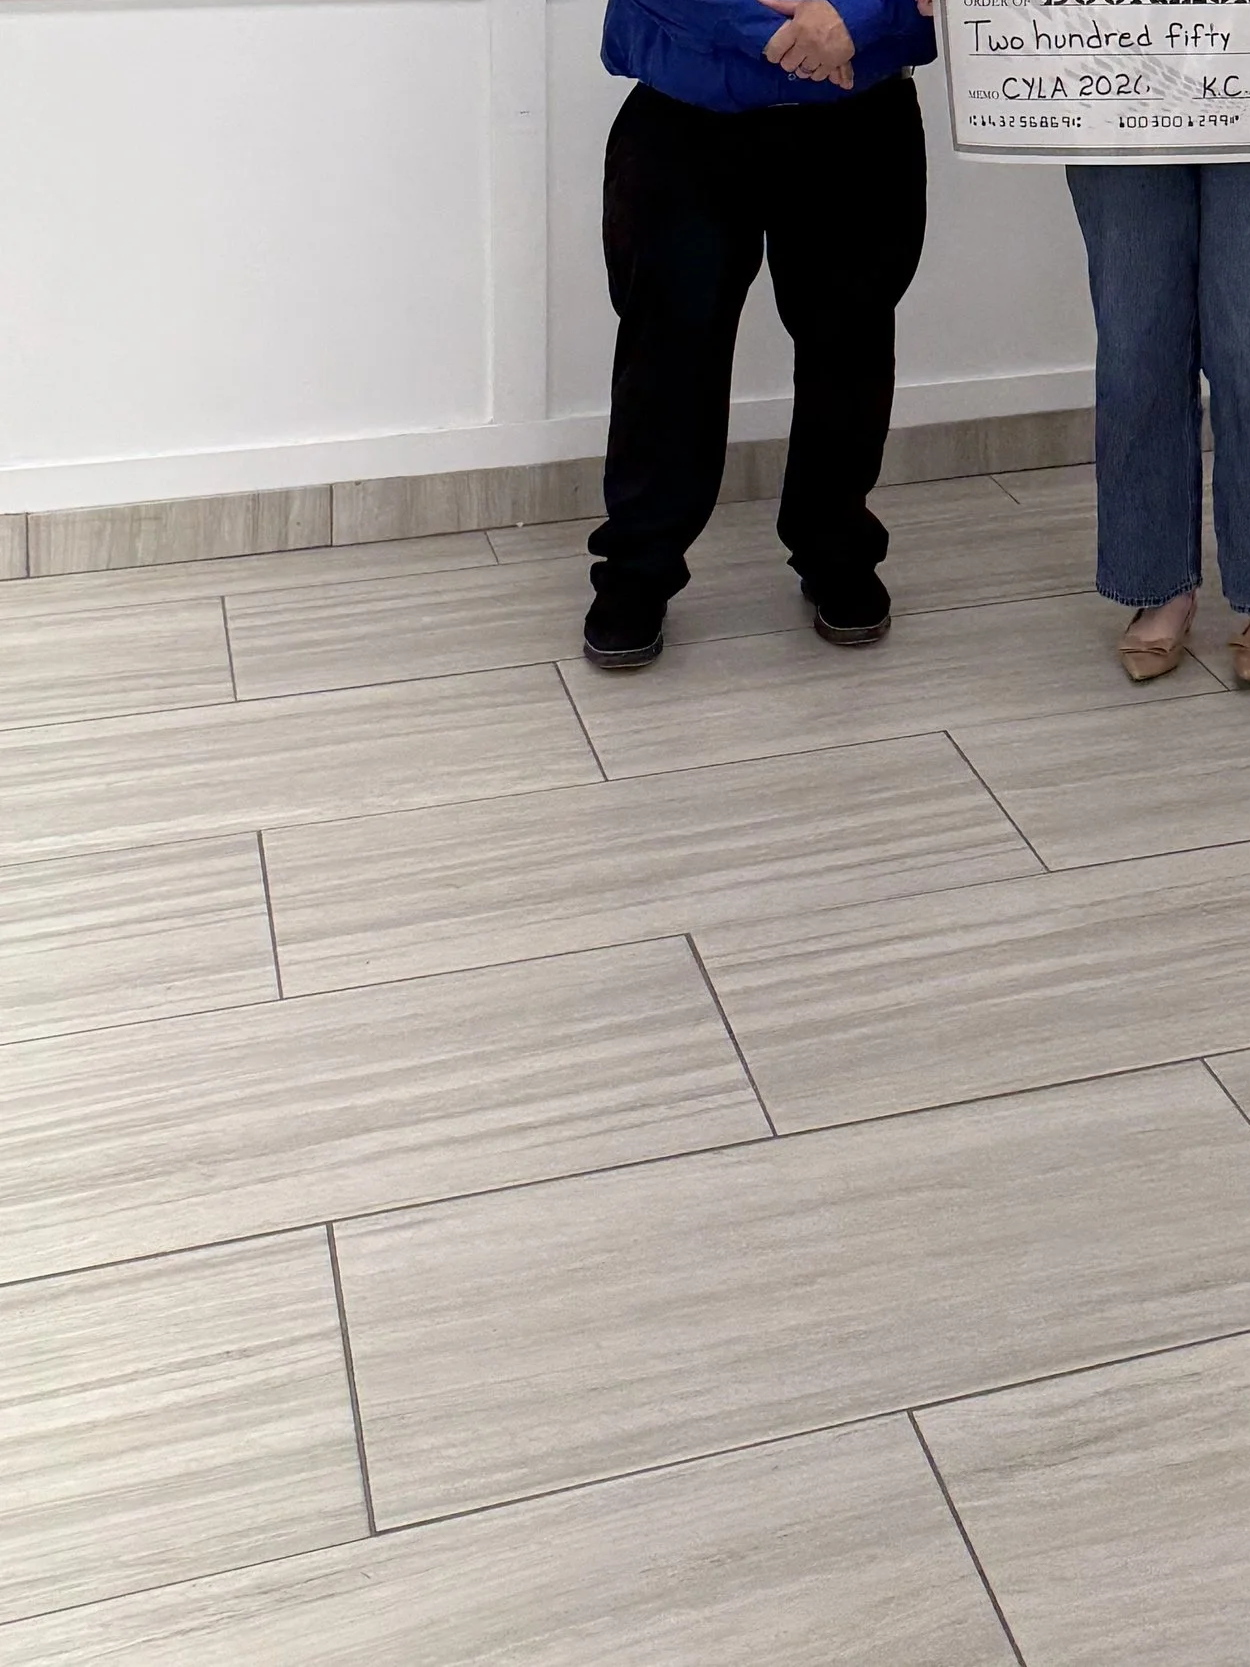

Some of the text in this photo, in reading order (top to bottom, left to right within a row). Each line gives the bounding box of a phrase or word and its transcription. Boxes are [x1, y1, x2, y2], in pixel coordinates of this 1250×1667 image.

[964, 19, 1231, 53] Two hundred fifty
[968, 89, 1000, 100] MEMO
[1001, 76, 1069, 101] CYLA
